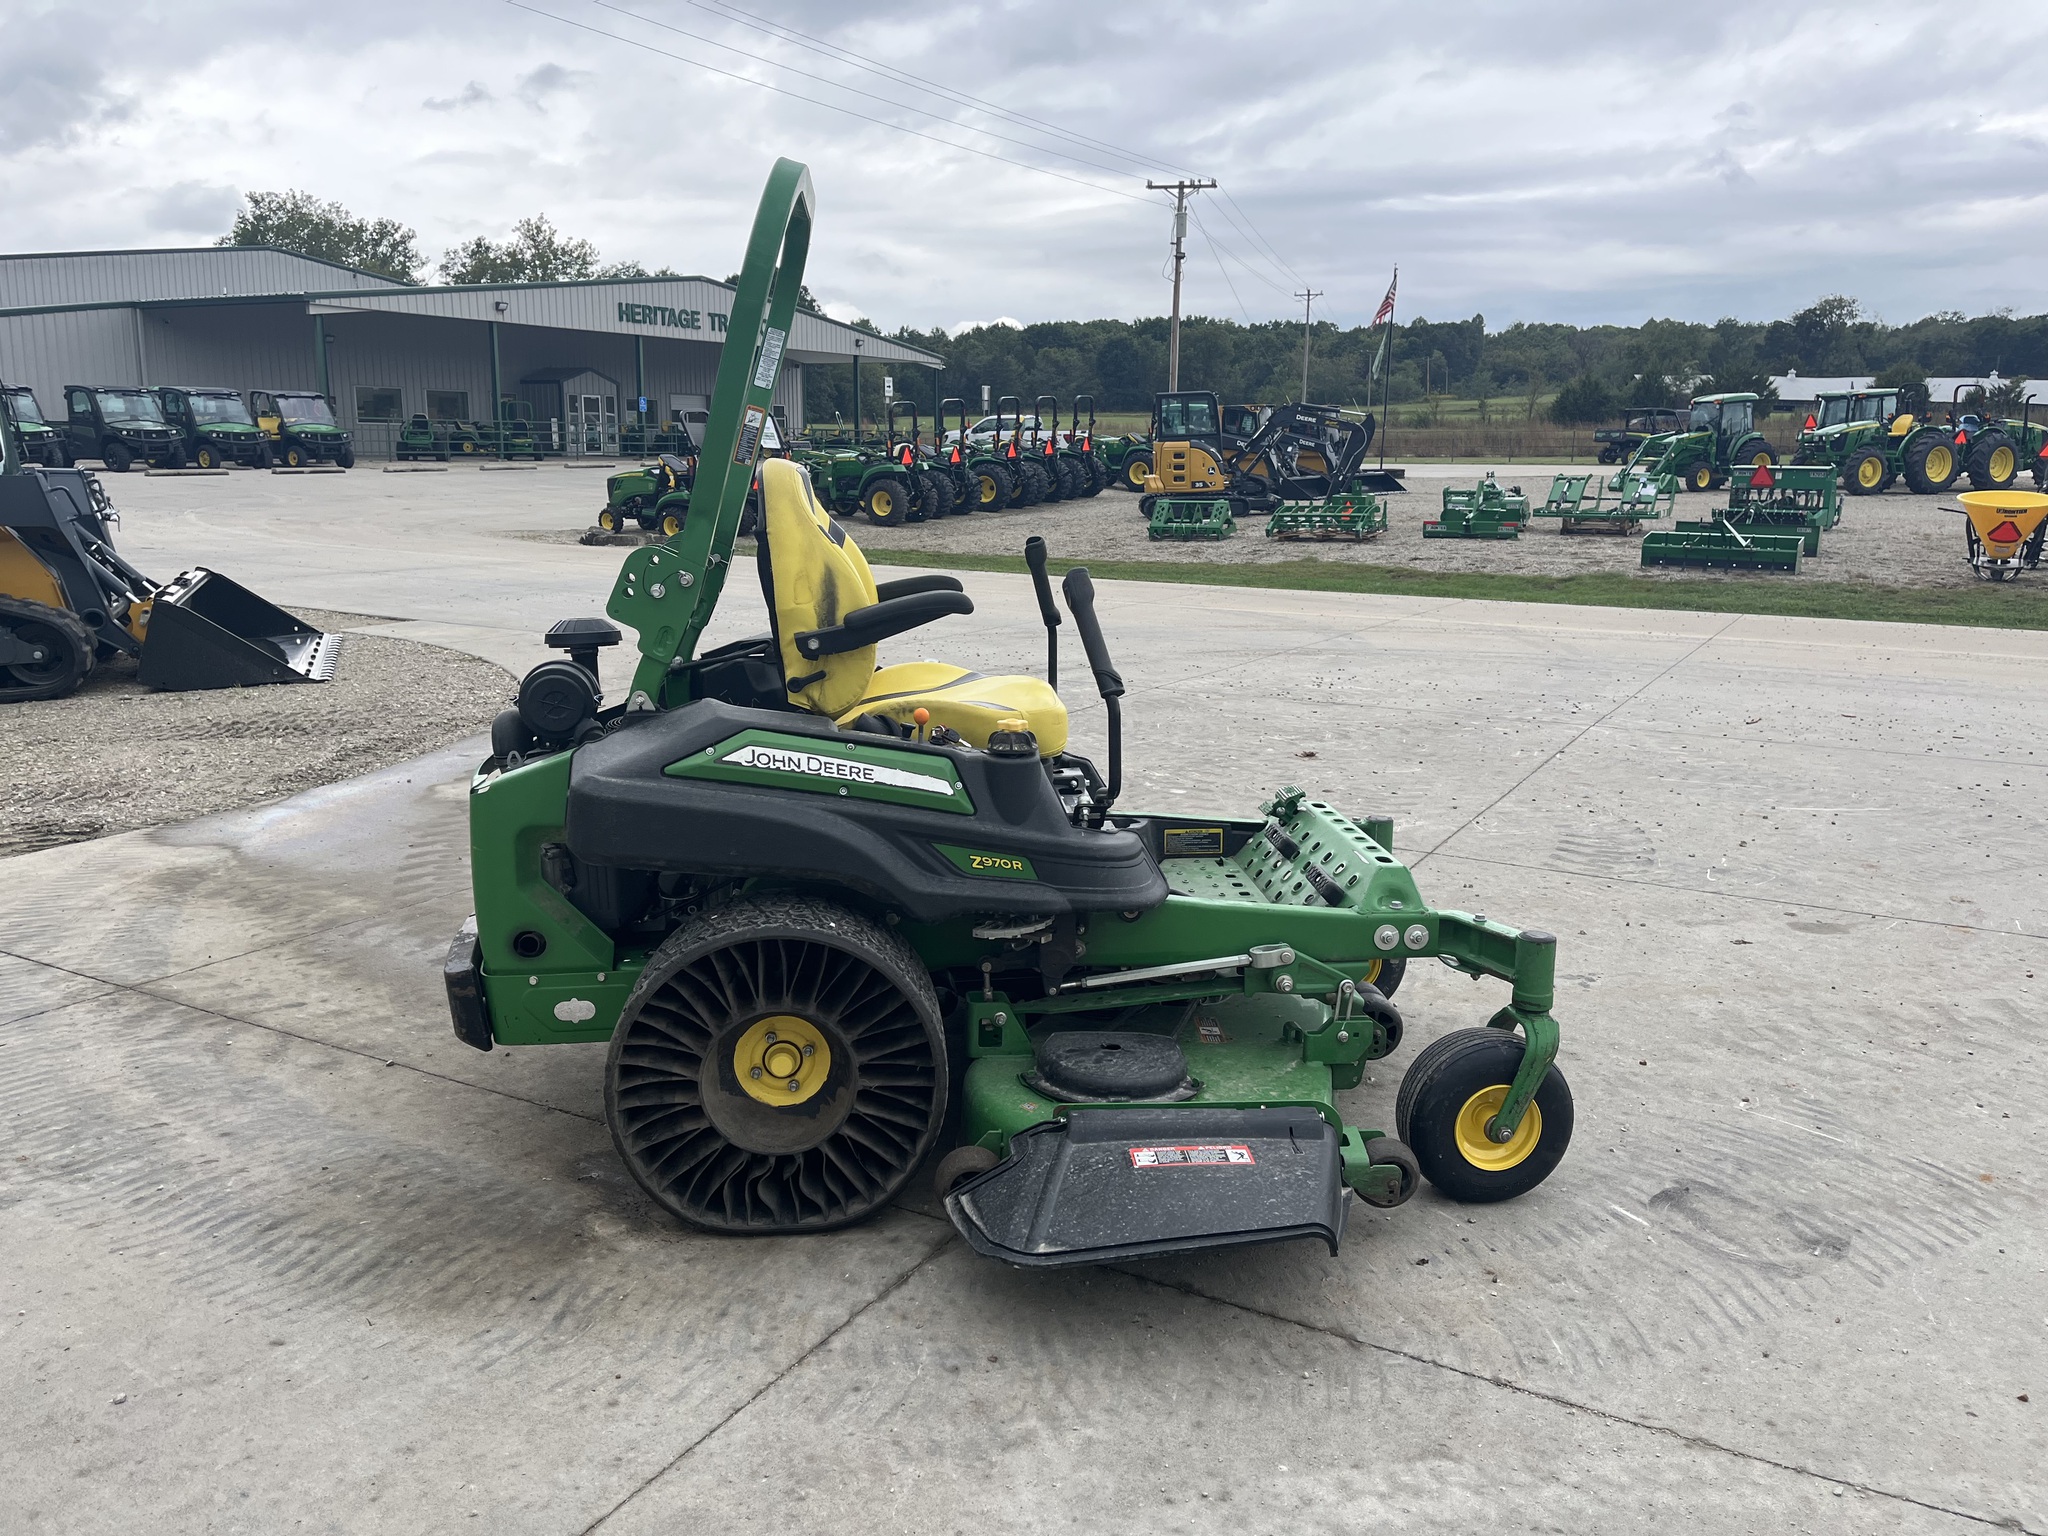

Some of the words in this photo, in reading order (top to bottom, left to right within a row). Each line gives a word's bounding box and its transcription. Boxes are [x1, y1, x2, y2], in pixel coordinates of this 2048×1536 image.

[618, 302, 701, 330] HERITAGE
[1296, 414, 1317, 424] DEERE
[1299, 438, 1315, 448] DEERE
[744, 748, 802, 772] JOHN
[806, 755, 875, 781] DEERE
[969, 854, 1024, 872] Z970R
